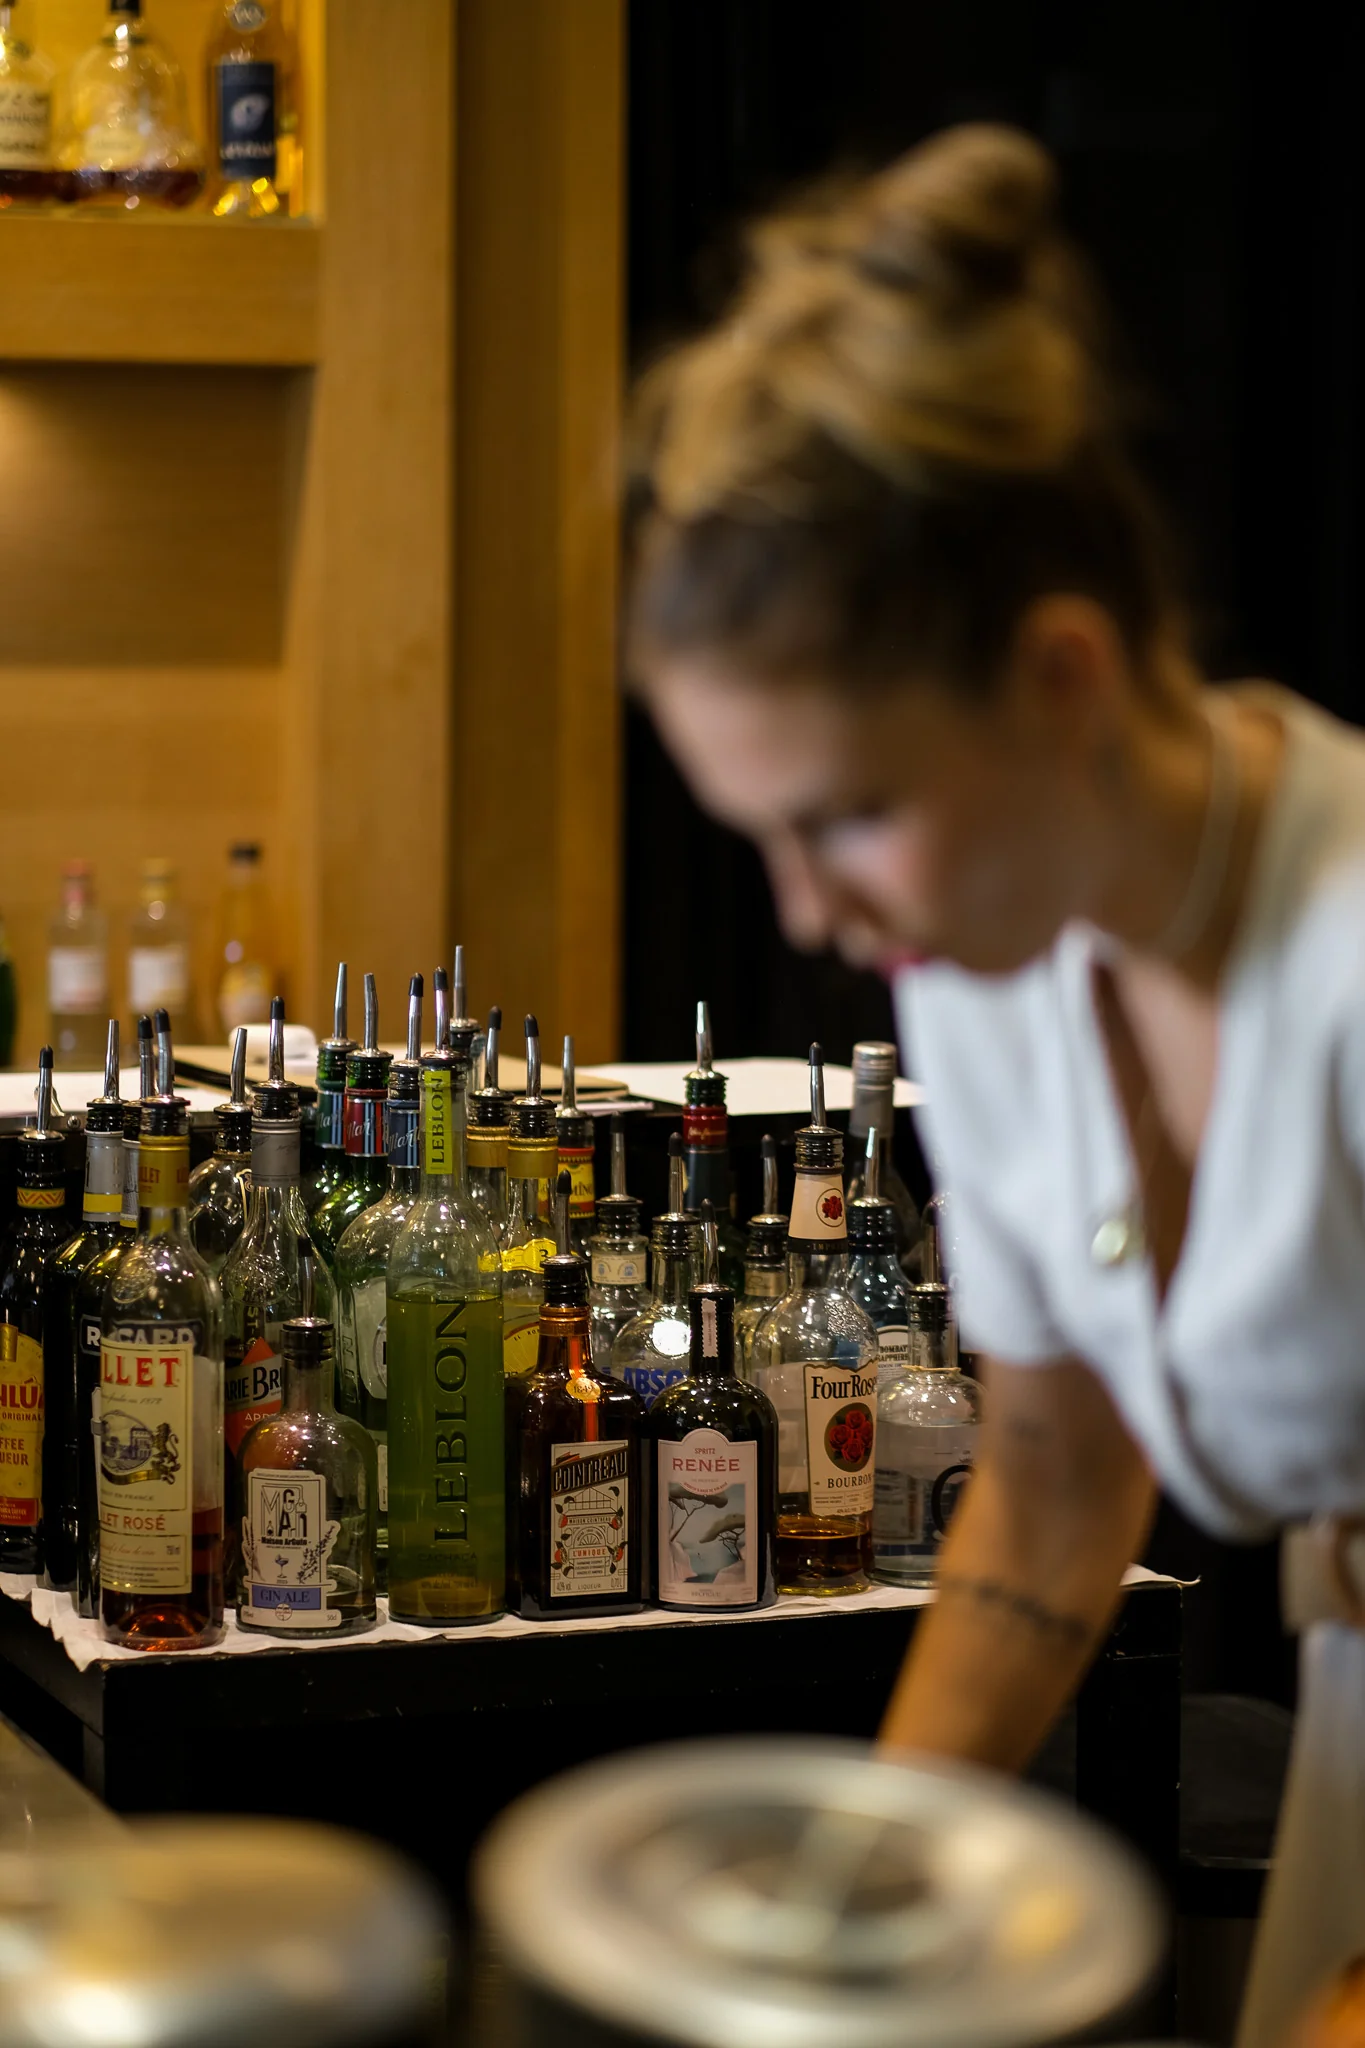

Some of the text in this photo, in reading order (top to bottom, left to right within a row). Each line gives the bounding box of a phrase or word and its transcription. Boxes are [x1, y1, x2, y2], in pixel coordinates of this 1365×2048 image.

[431, 1078, 445, 1164] LEBLON
[87, 1326, 195, 1346] RCARD
[624, 1367, 689, 1396] ABSO
[2, 1411, 42, 1421] ORIGINAL
[434, 1299, 468, 1541] LEBLON
[694, 1447, 716, 1455] SPRITZ
[554, 1451, 628, 1493] COINTREAU
[672, 1456, 740, 1472] RENÉE
[123, 1514, 166, 1531] ROSÉ
[573, 1548, 606, 1557] L'UNIQUE
[260, 1589, 311, 1603] GIN ALE
